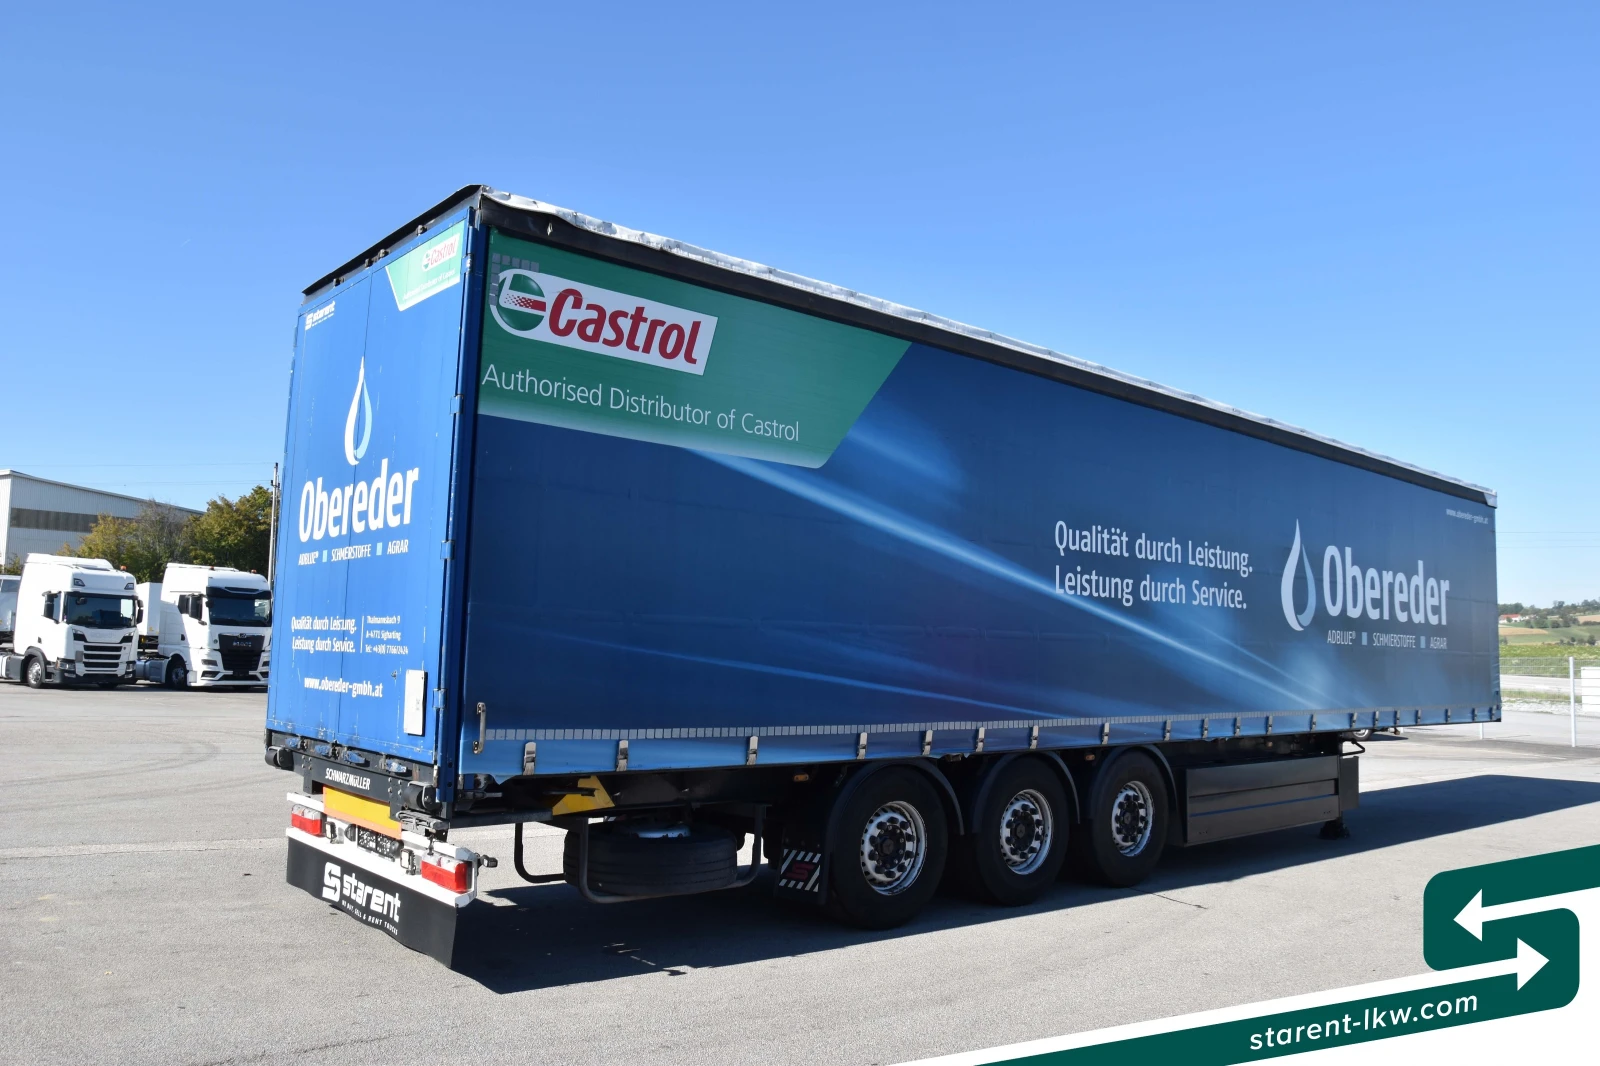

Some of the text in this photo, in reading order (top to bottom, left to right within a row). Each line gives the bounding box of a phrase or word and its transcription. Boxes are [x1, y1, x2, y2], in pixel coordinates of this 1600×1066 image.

[430, 238, 457, 266] Castrol
[548, 288, 702, 365] Castrol
[482, 363, 799, 442] Authorised Distributor of Castrol
[298, 458, 420, 543] Obereder
[387, 539, 409, 555] AGRAR
[1055, 520, 1253, 578] Qualität durch Leistung.
[1055, 564, 1248, 610] Leistung durch Service.
[1322, 545, 1450, 626] Obereder
[291, 615, 357, 635] Qualität durch Leistung.
[292, 636, 356, 653] Leistung durch Service.
[1372, 632, 1416, 648] SCHMIERSTOFFE
[1429, 636, 1448, 650] AGRAR
[304, 677, 383, 698] www.obereder-gmbh.at
[324, 767, 371, 791] SCHWARZMÜLLER
[342, 872, 401, 923] starent
[368, 915, 383, 925] RENT
